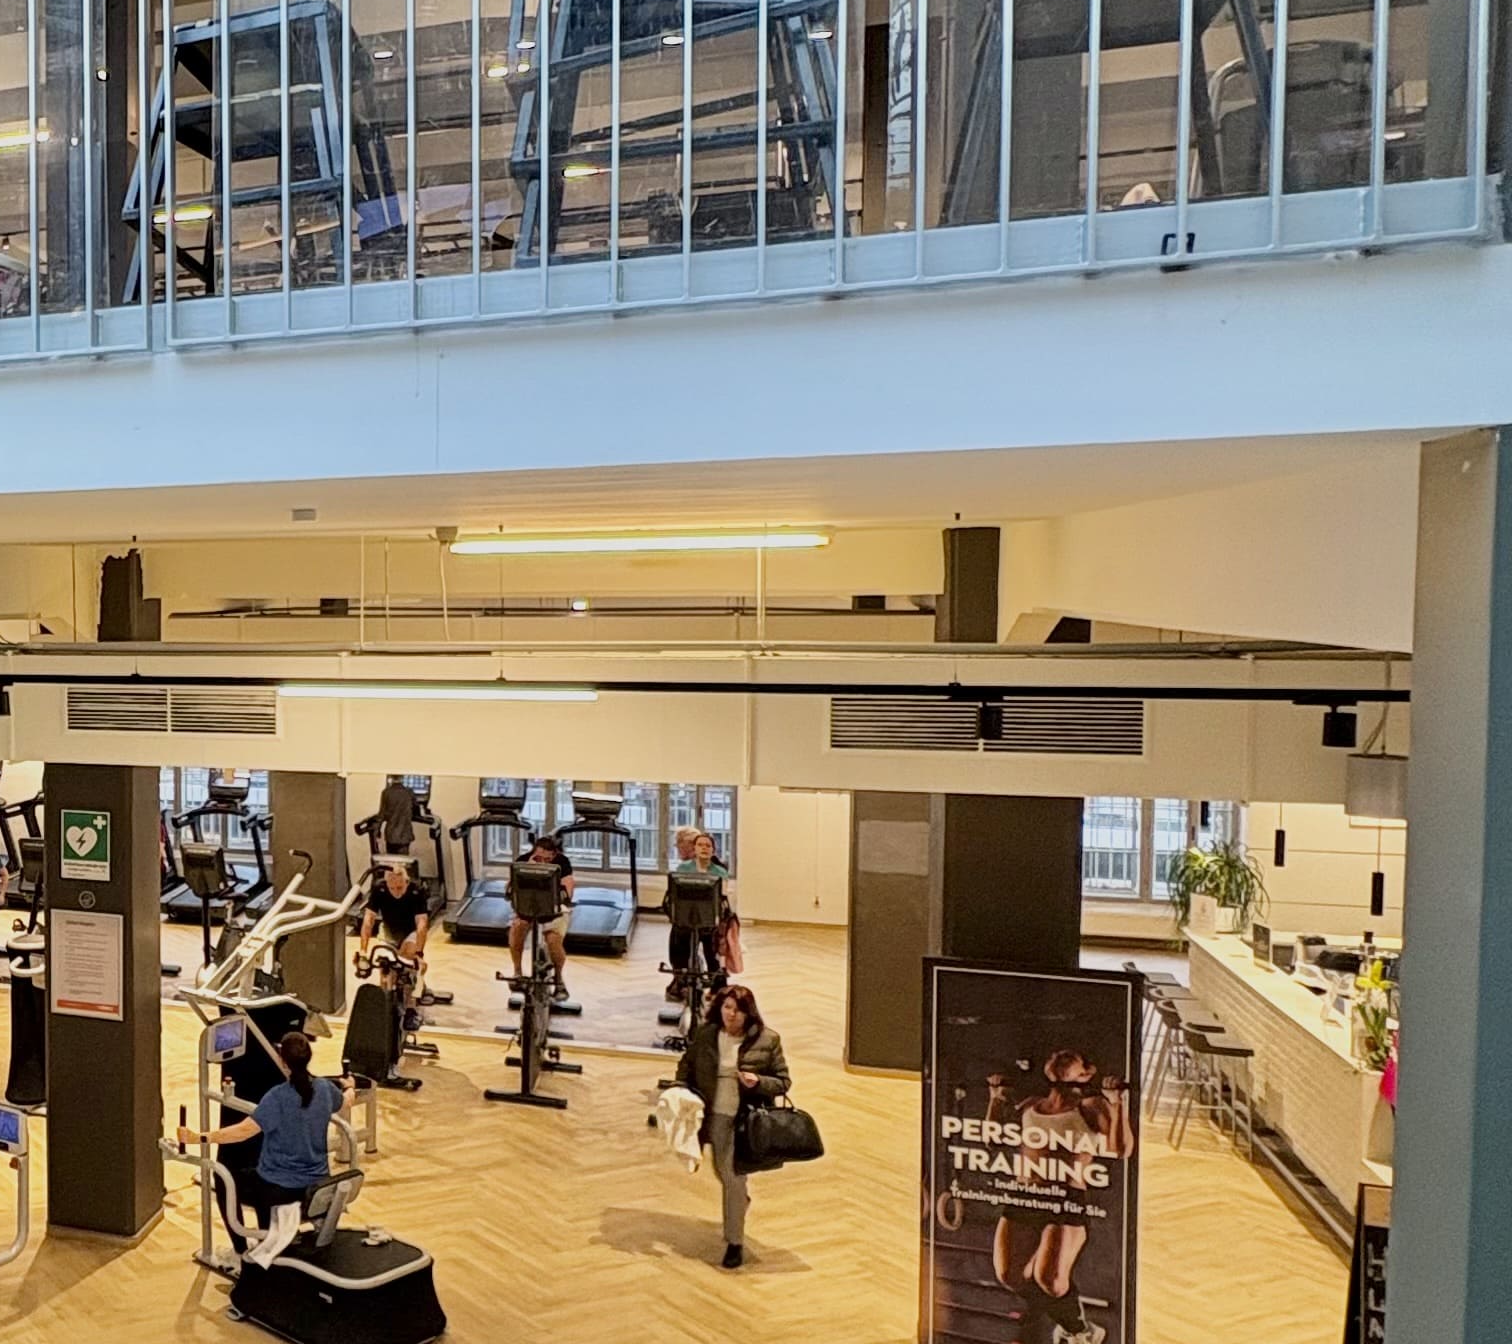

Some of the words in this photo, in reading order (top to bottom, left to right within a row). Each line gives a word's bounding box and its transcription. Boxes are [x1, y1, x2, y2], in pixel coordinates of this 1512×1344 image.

[941, 1115, 1118, 1159] PERSONAL
[948, 1145, 1110, 1188] TRAINING
[1064, 1201, 1084, 1214] für
[1086, 1204, 1107, 1218] Sie
